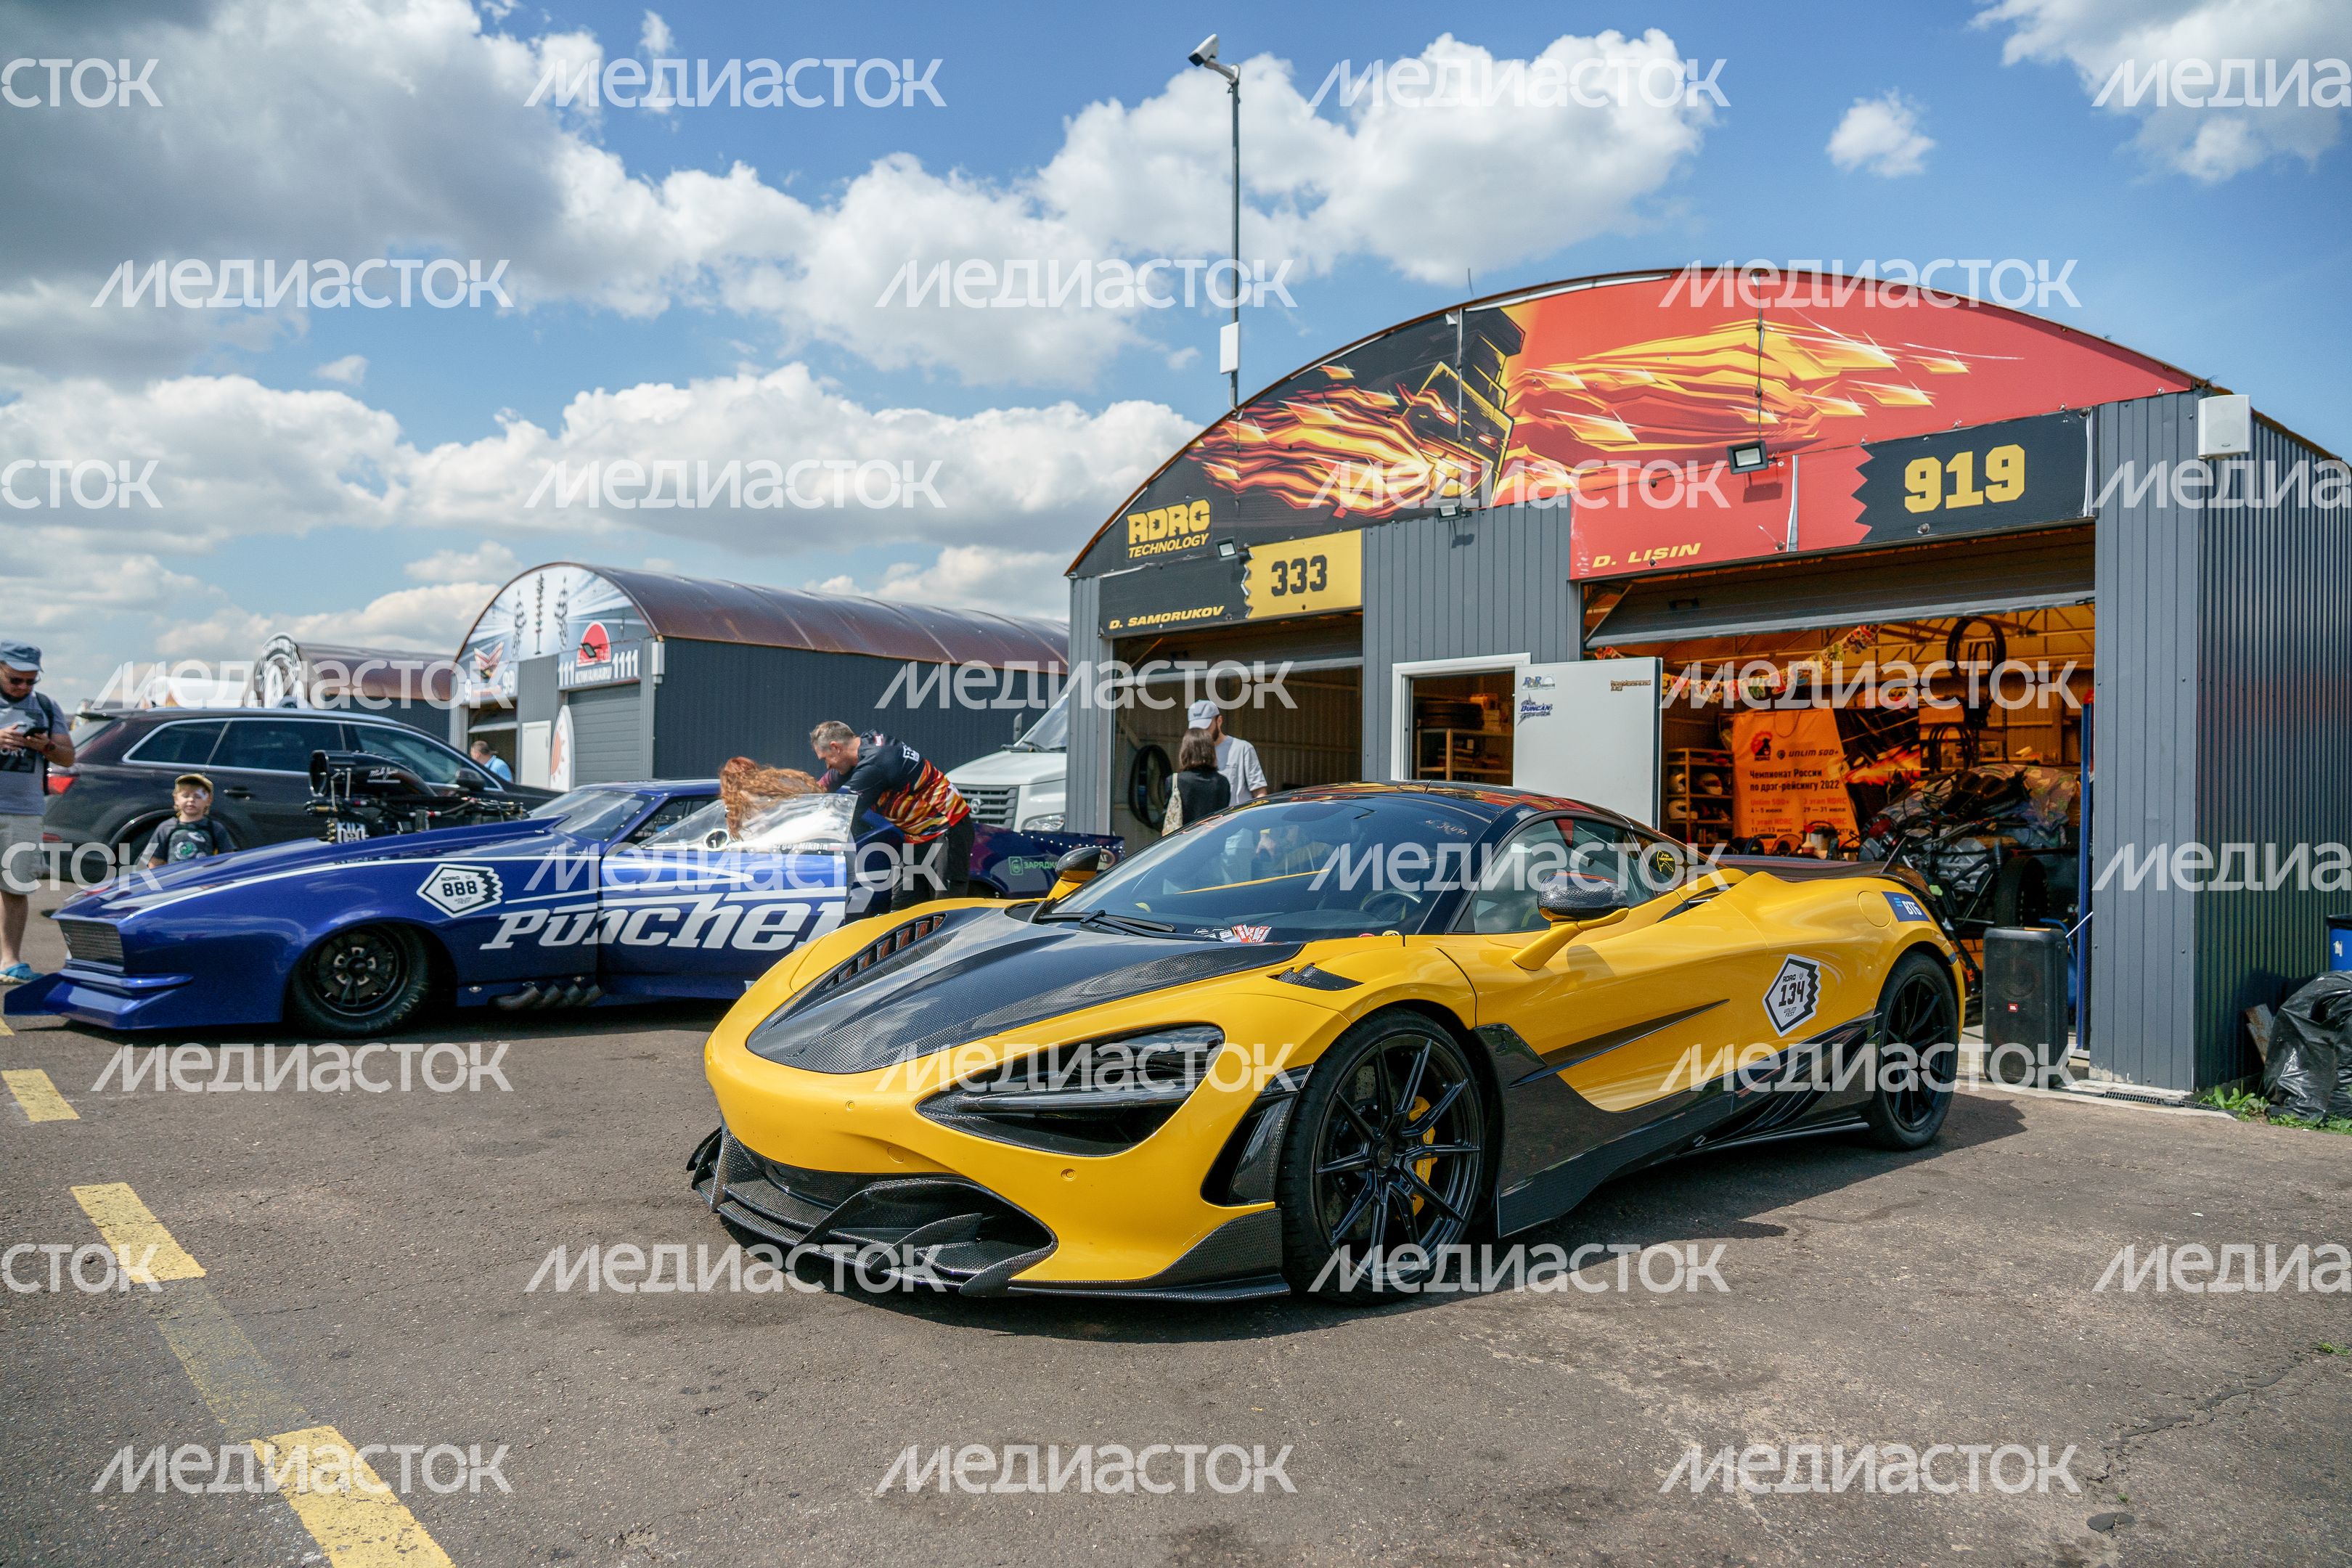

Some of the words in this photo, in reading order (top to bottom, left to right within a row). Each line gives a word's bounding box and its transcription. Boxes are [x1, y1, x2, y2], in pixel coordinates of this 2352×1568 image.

[1904, 444, 2025, 513] 919
[1127, 499, 1211, 544] RDRC
[1128, 533, 1209, 558] TECHNOLOGY
[1593, 554, 1617, 568] D.
[1628, 542, 1702, 564] LISIN
[1271, 554, 1328, 597] 333
[1108, 618, 1124, 630] D.
[1127, 605, 1225, 626] SAMORUKOV
[1749, 770, 1791, 779] Чемпионат
[1794, 769, 1822, 777] России
[1760, 781, 1818, 793] дрэг-рейсингу
[1821, 780, 1839, 790] 2022
[1023, 861, 1058, 870] ЗАРЯДК
[442, 881, 478, 897] 888
[1901, 900, 1922, 916] ВТБ
[1778, 980, 1805, 1008] 134
